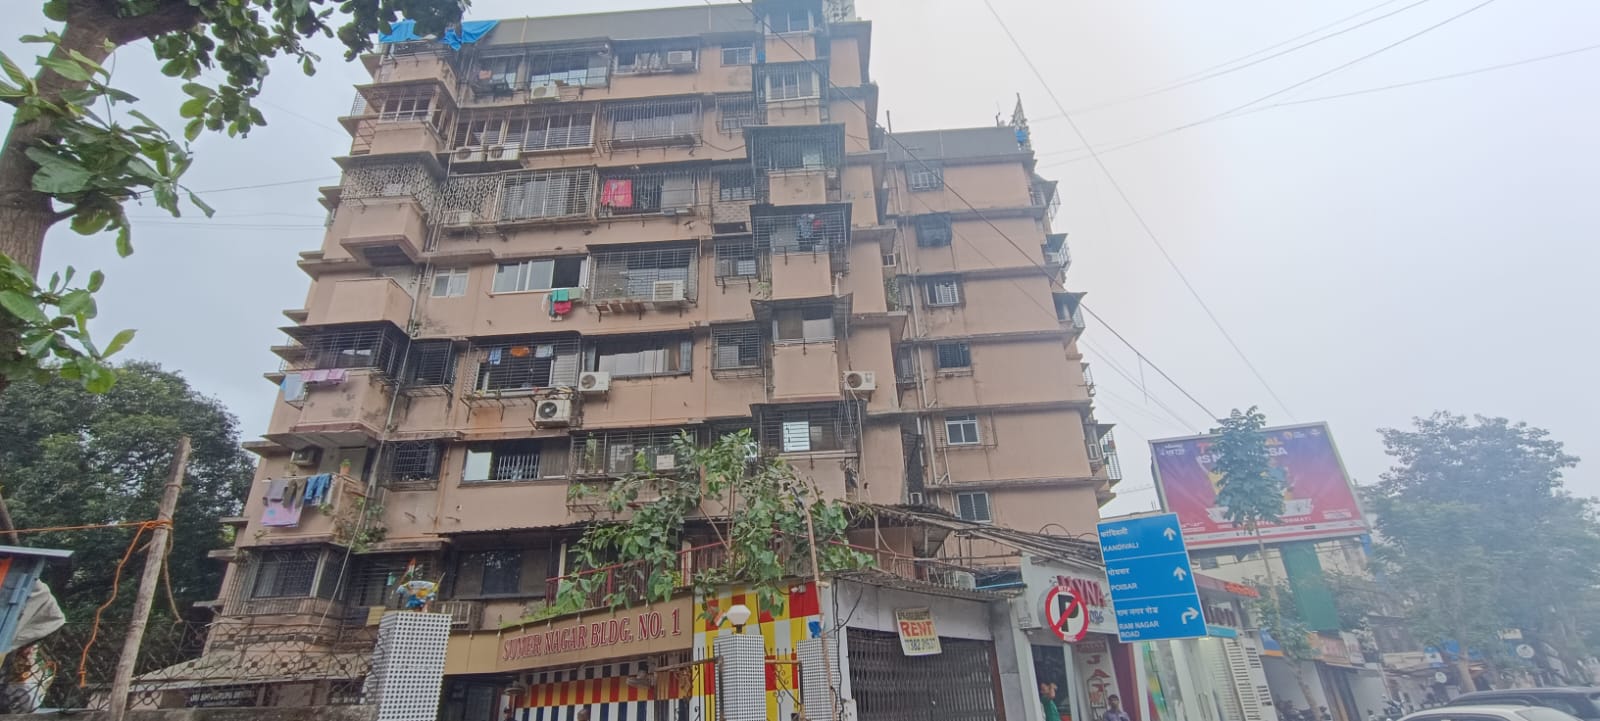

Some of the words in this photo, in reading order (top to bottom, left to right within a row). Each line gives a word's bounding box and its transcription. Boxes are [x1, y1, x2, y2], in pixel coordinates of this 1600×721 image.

[1103, 543, 1139, 552] KANDIVALI
[1111, 583, 1138, 591] POISAR
[900, 621, 933, 638] RENT
[1119, 622, 1134, 630] RAM
[1135, 620, 1160, 629] NAGAR
[503, 635, 542, 661] SUMER
[544, 625, 587, 655] NAGAR
[638, 611, 665, 643] NO.
[671, 608, 681, 636] 1
